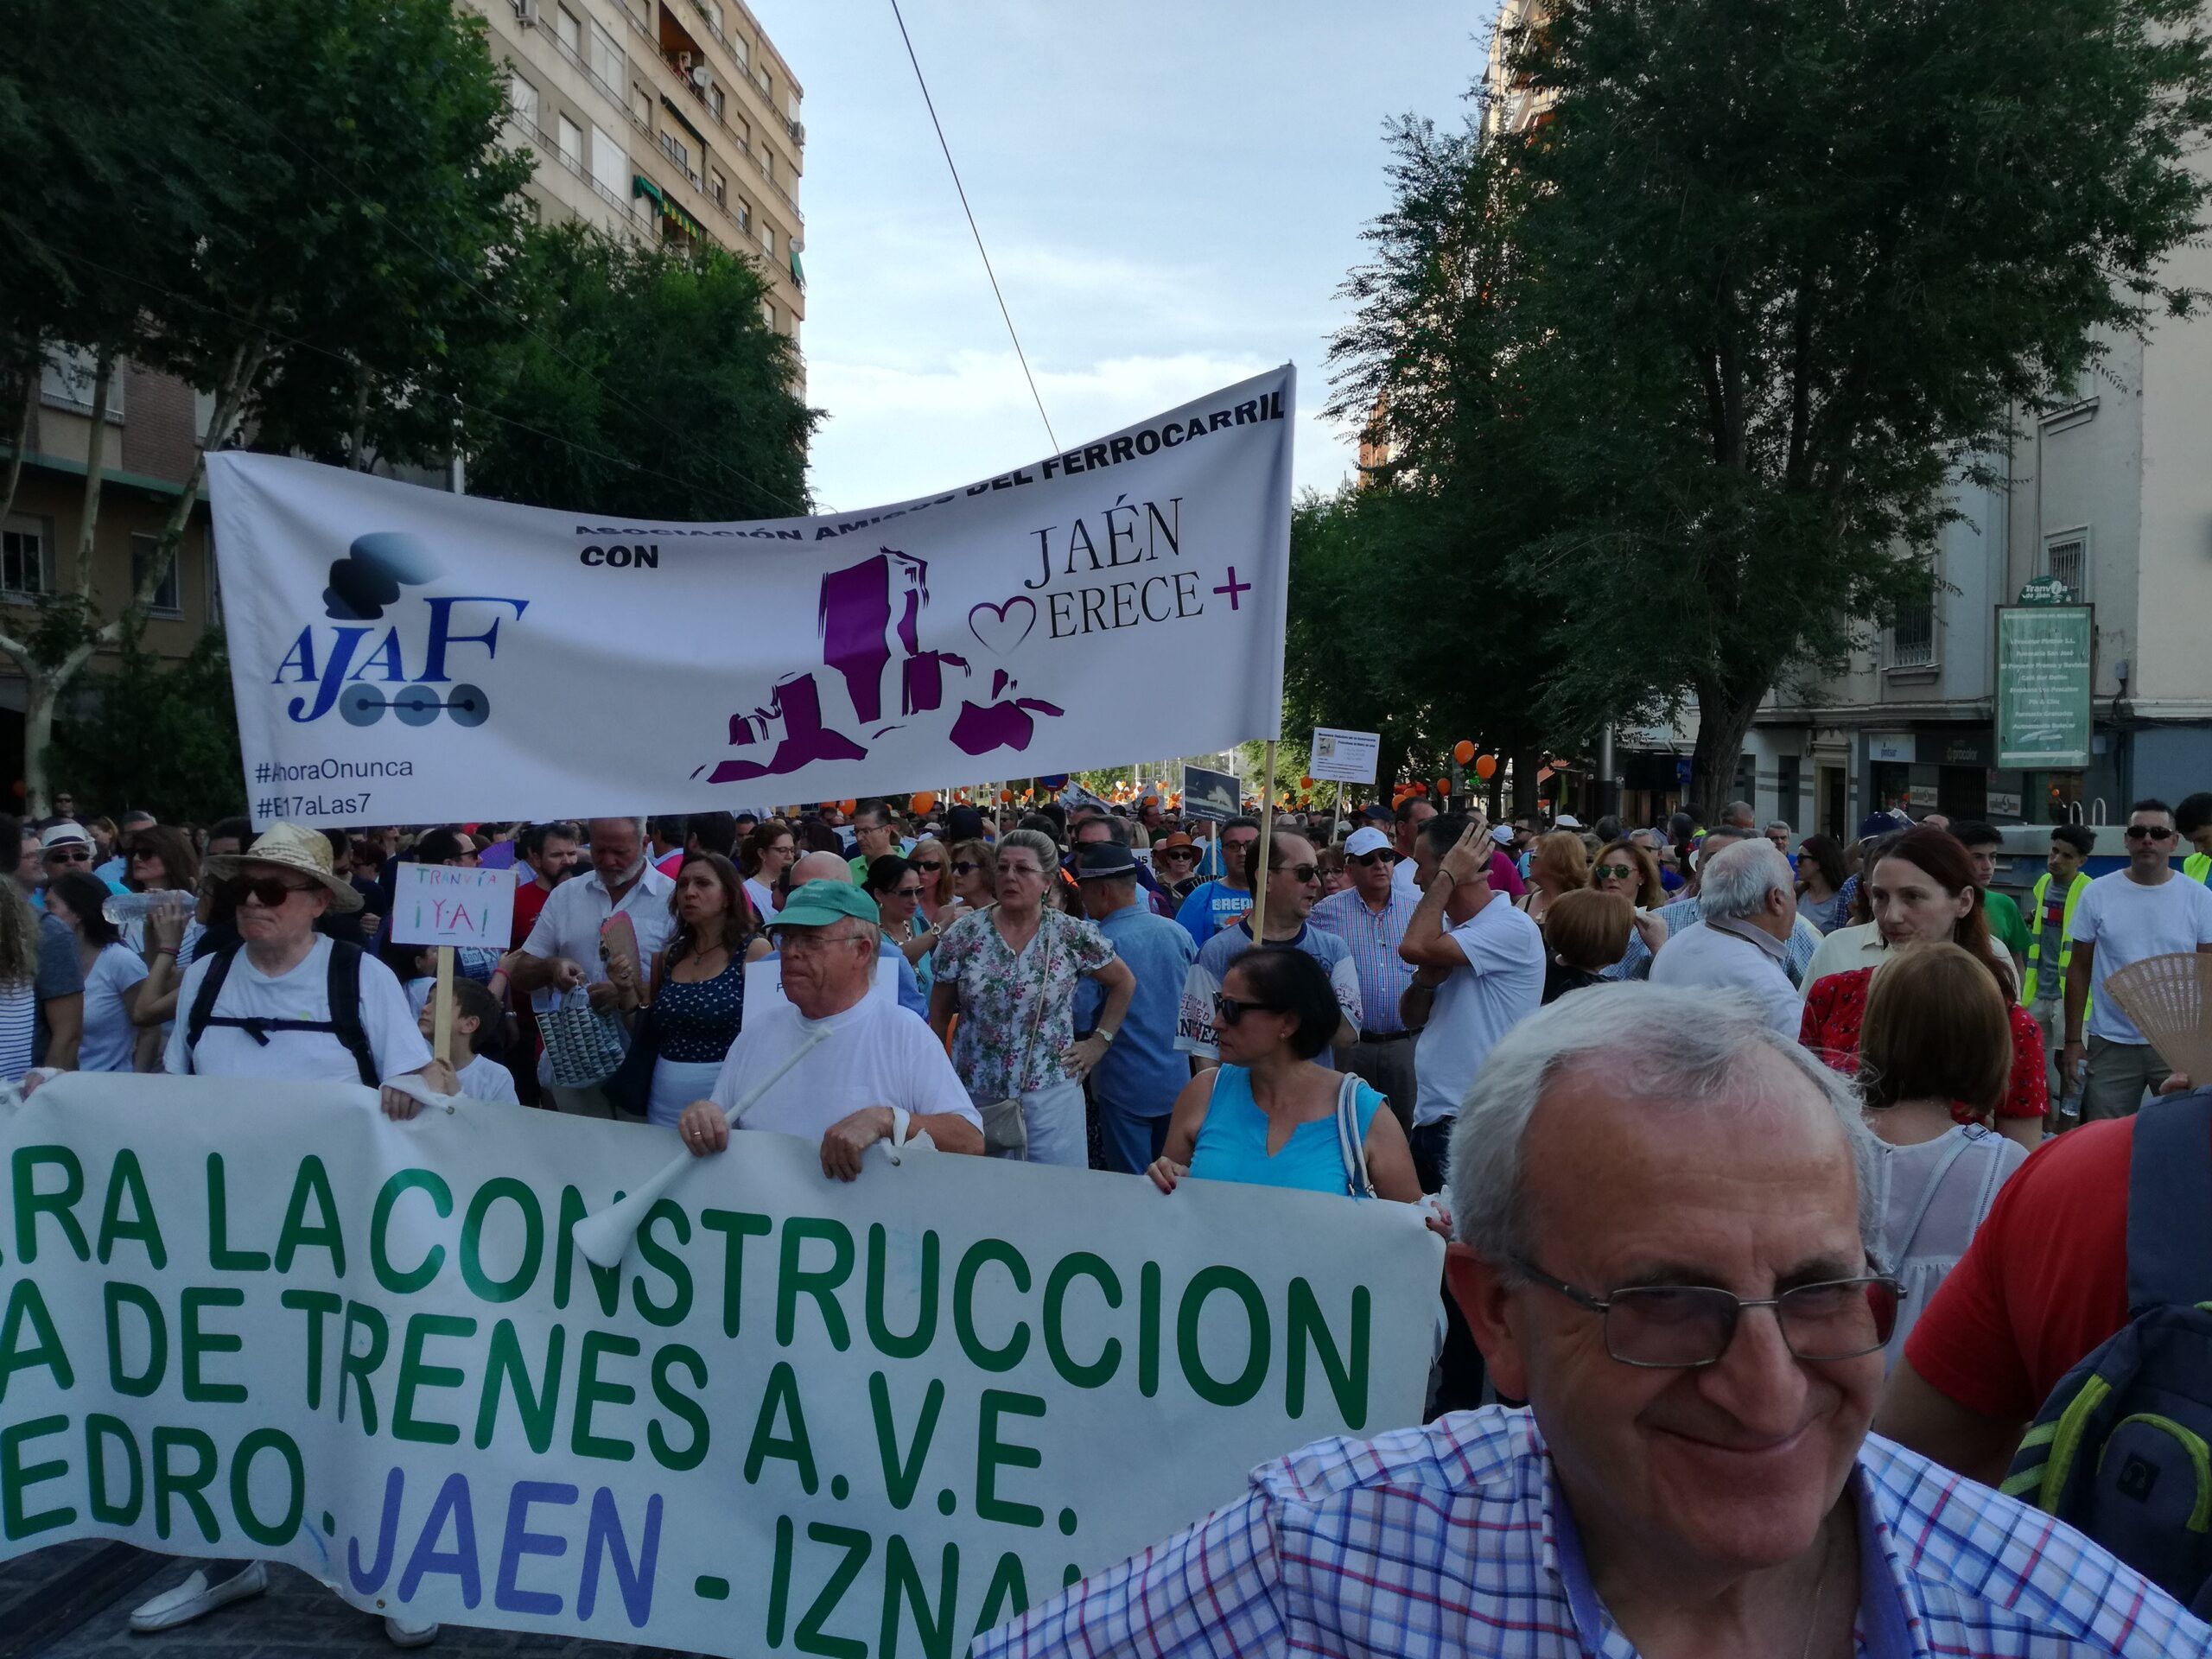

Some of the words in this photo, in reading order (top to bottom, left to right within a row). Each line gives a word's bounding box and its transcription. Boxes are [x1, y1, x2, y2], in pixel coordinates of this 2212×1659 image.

[1041, 391, 1285, 480] FERROCARRIL
[580, 544, 659, 569] CON
[1024, 493, 1183, 589] JAÉN
[270, 596, 530, 723] AJAF
[0, 1144, 167, 1270] RA
[207, 1153, 346, 1278] LA
[370, 1167, 1370, 1431] CONSTRUCCION
[104, 1281, 249, 1403] DE
[281, 1288, 711, 1472] TRENES
[744, 1361, 1078, 1536] A.V.E.
[348, 1466, 664, 1629] JAEN
[766, 1514, 1082, 1659] IZNA
